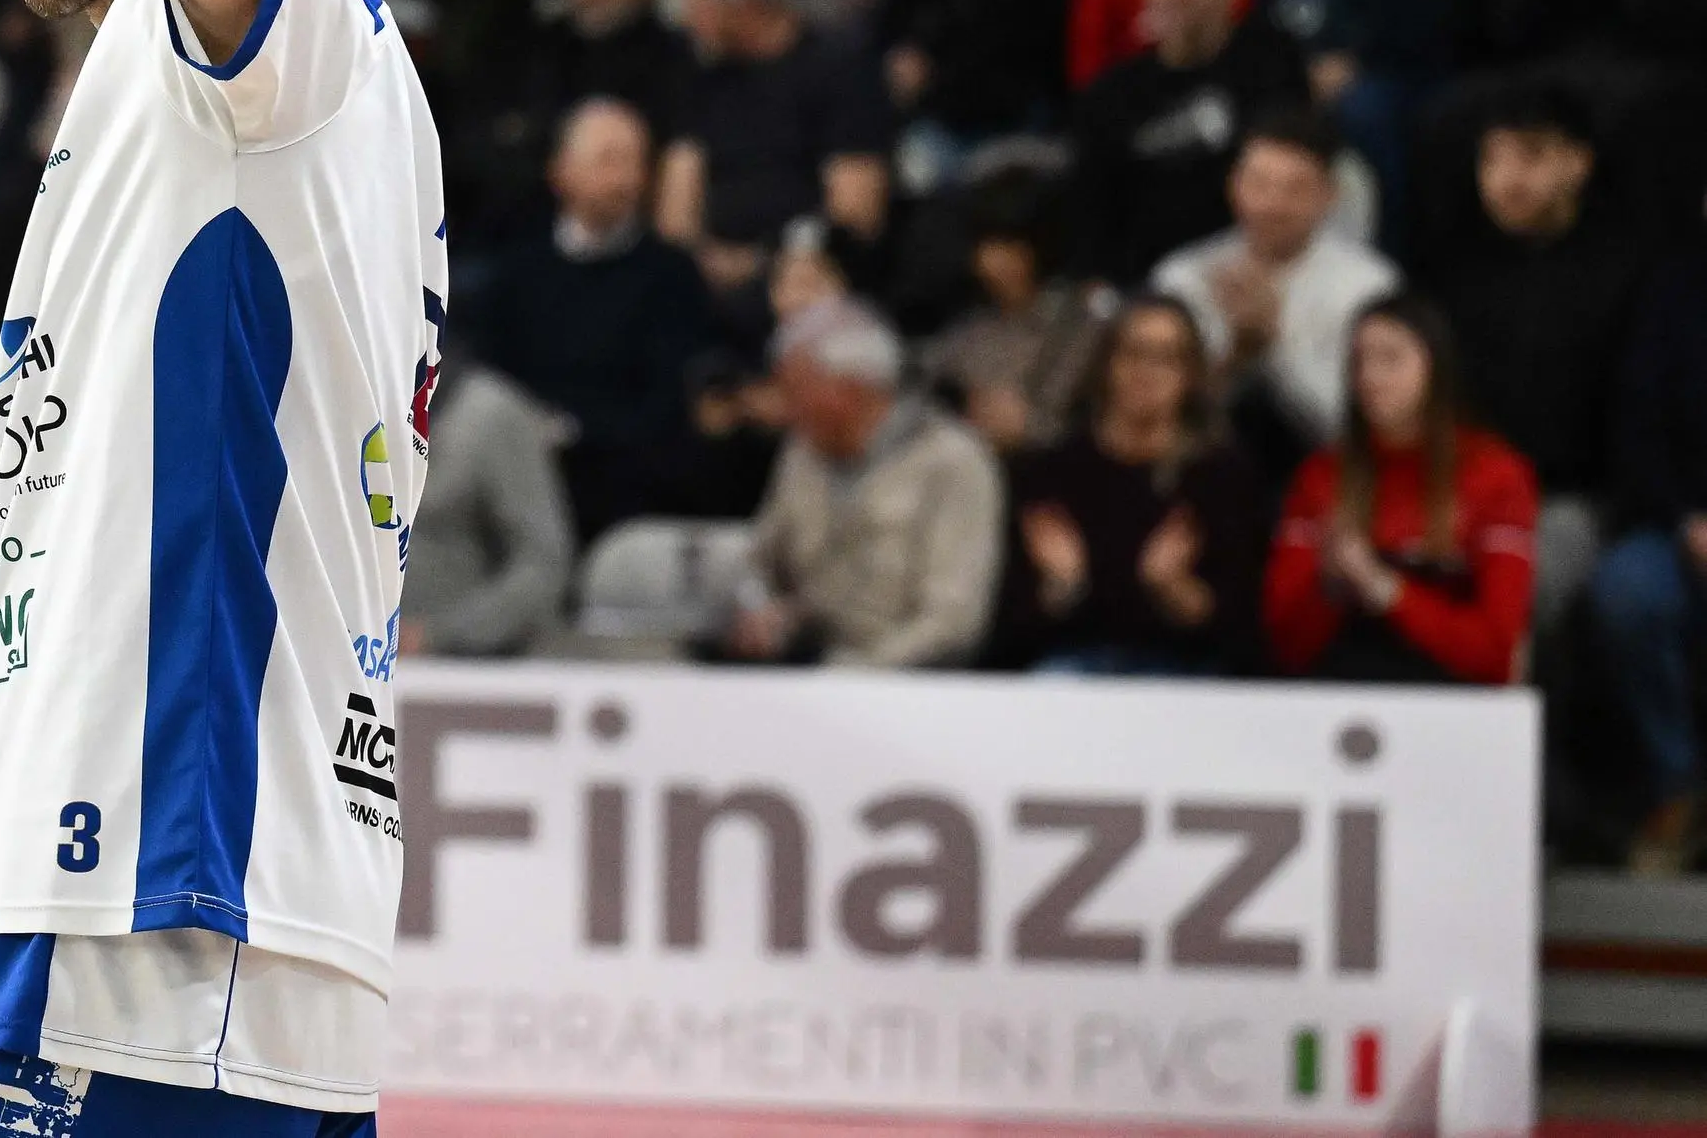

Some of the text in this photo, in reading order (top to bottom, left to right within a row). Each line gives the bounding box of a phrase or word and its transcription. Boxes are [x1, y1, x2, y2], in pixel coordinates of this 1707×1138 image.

[57, 801, 101, 873] 3
[397, 700, 1383, 974] Finazzi
[957, 1010, 1049, 1092] IN
[1071, 1012, 1250, 1104] PVC
